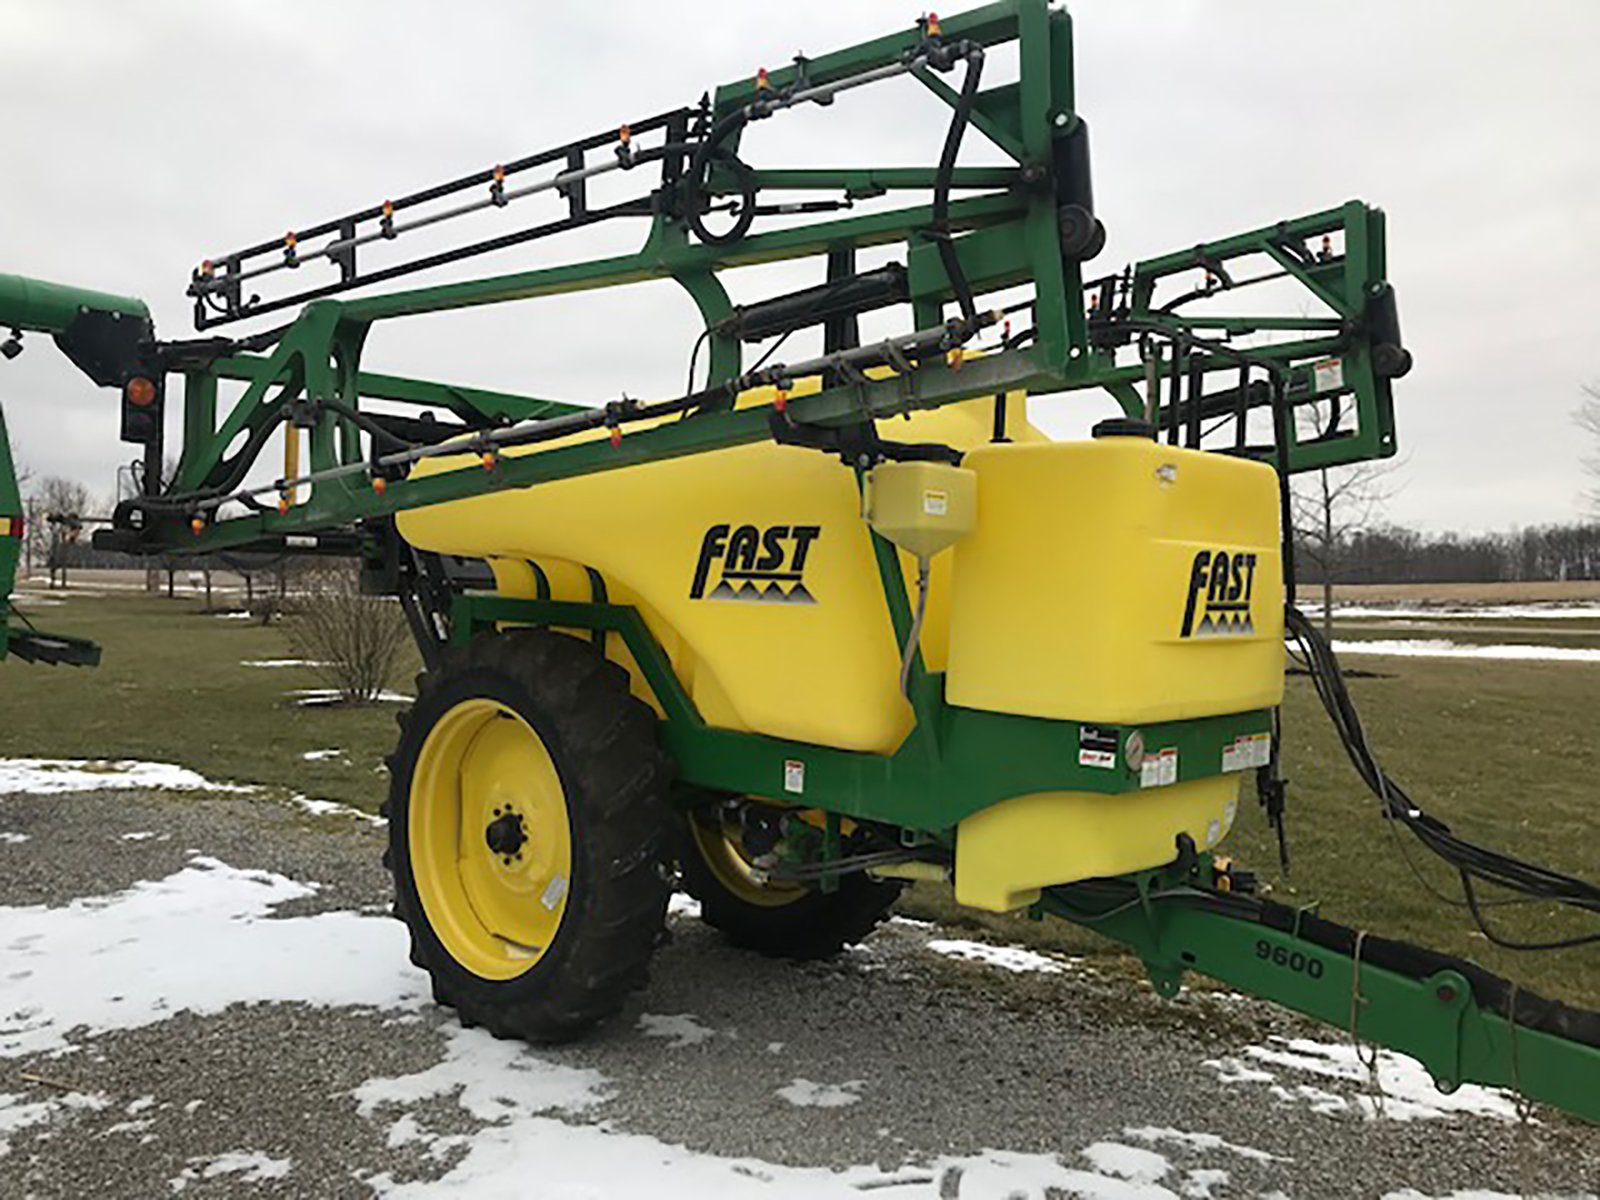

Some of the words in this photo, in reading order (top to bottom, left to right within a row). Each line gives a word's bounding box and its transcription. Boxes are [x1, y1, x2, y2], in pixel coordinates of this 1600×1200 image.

[690, 524, 821, 599] FAST
[1180, 550, 1257, 638] FAST
[1256, 939, 1324, 979] 9600
